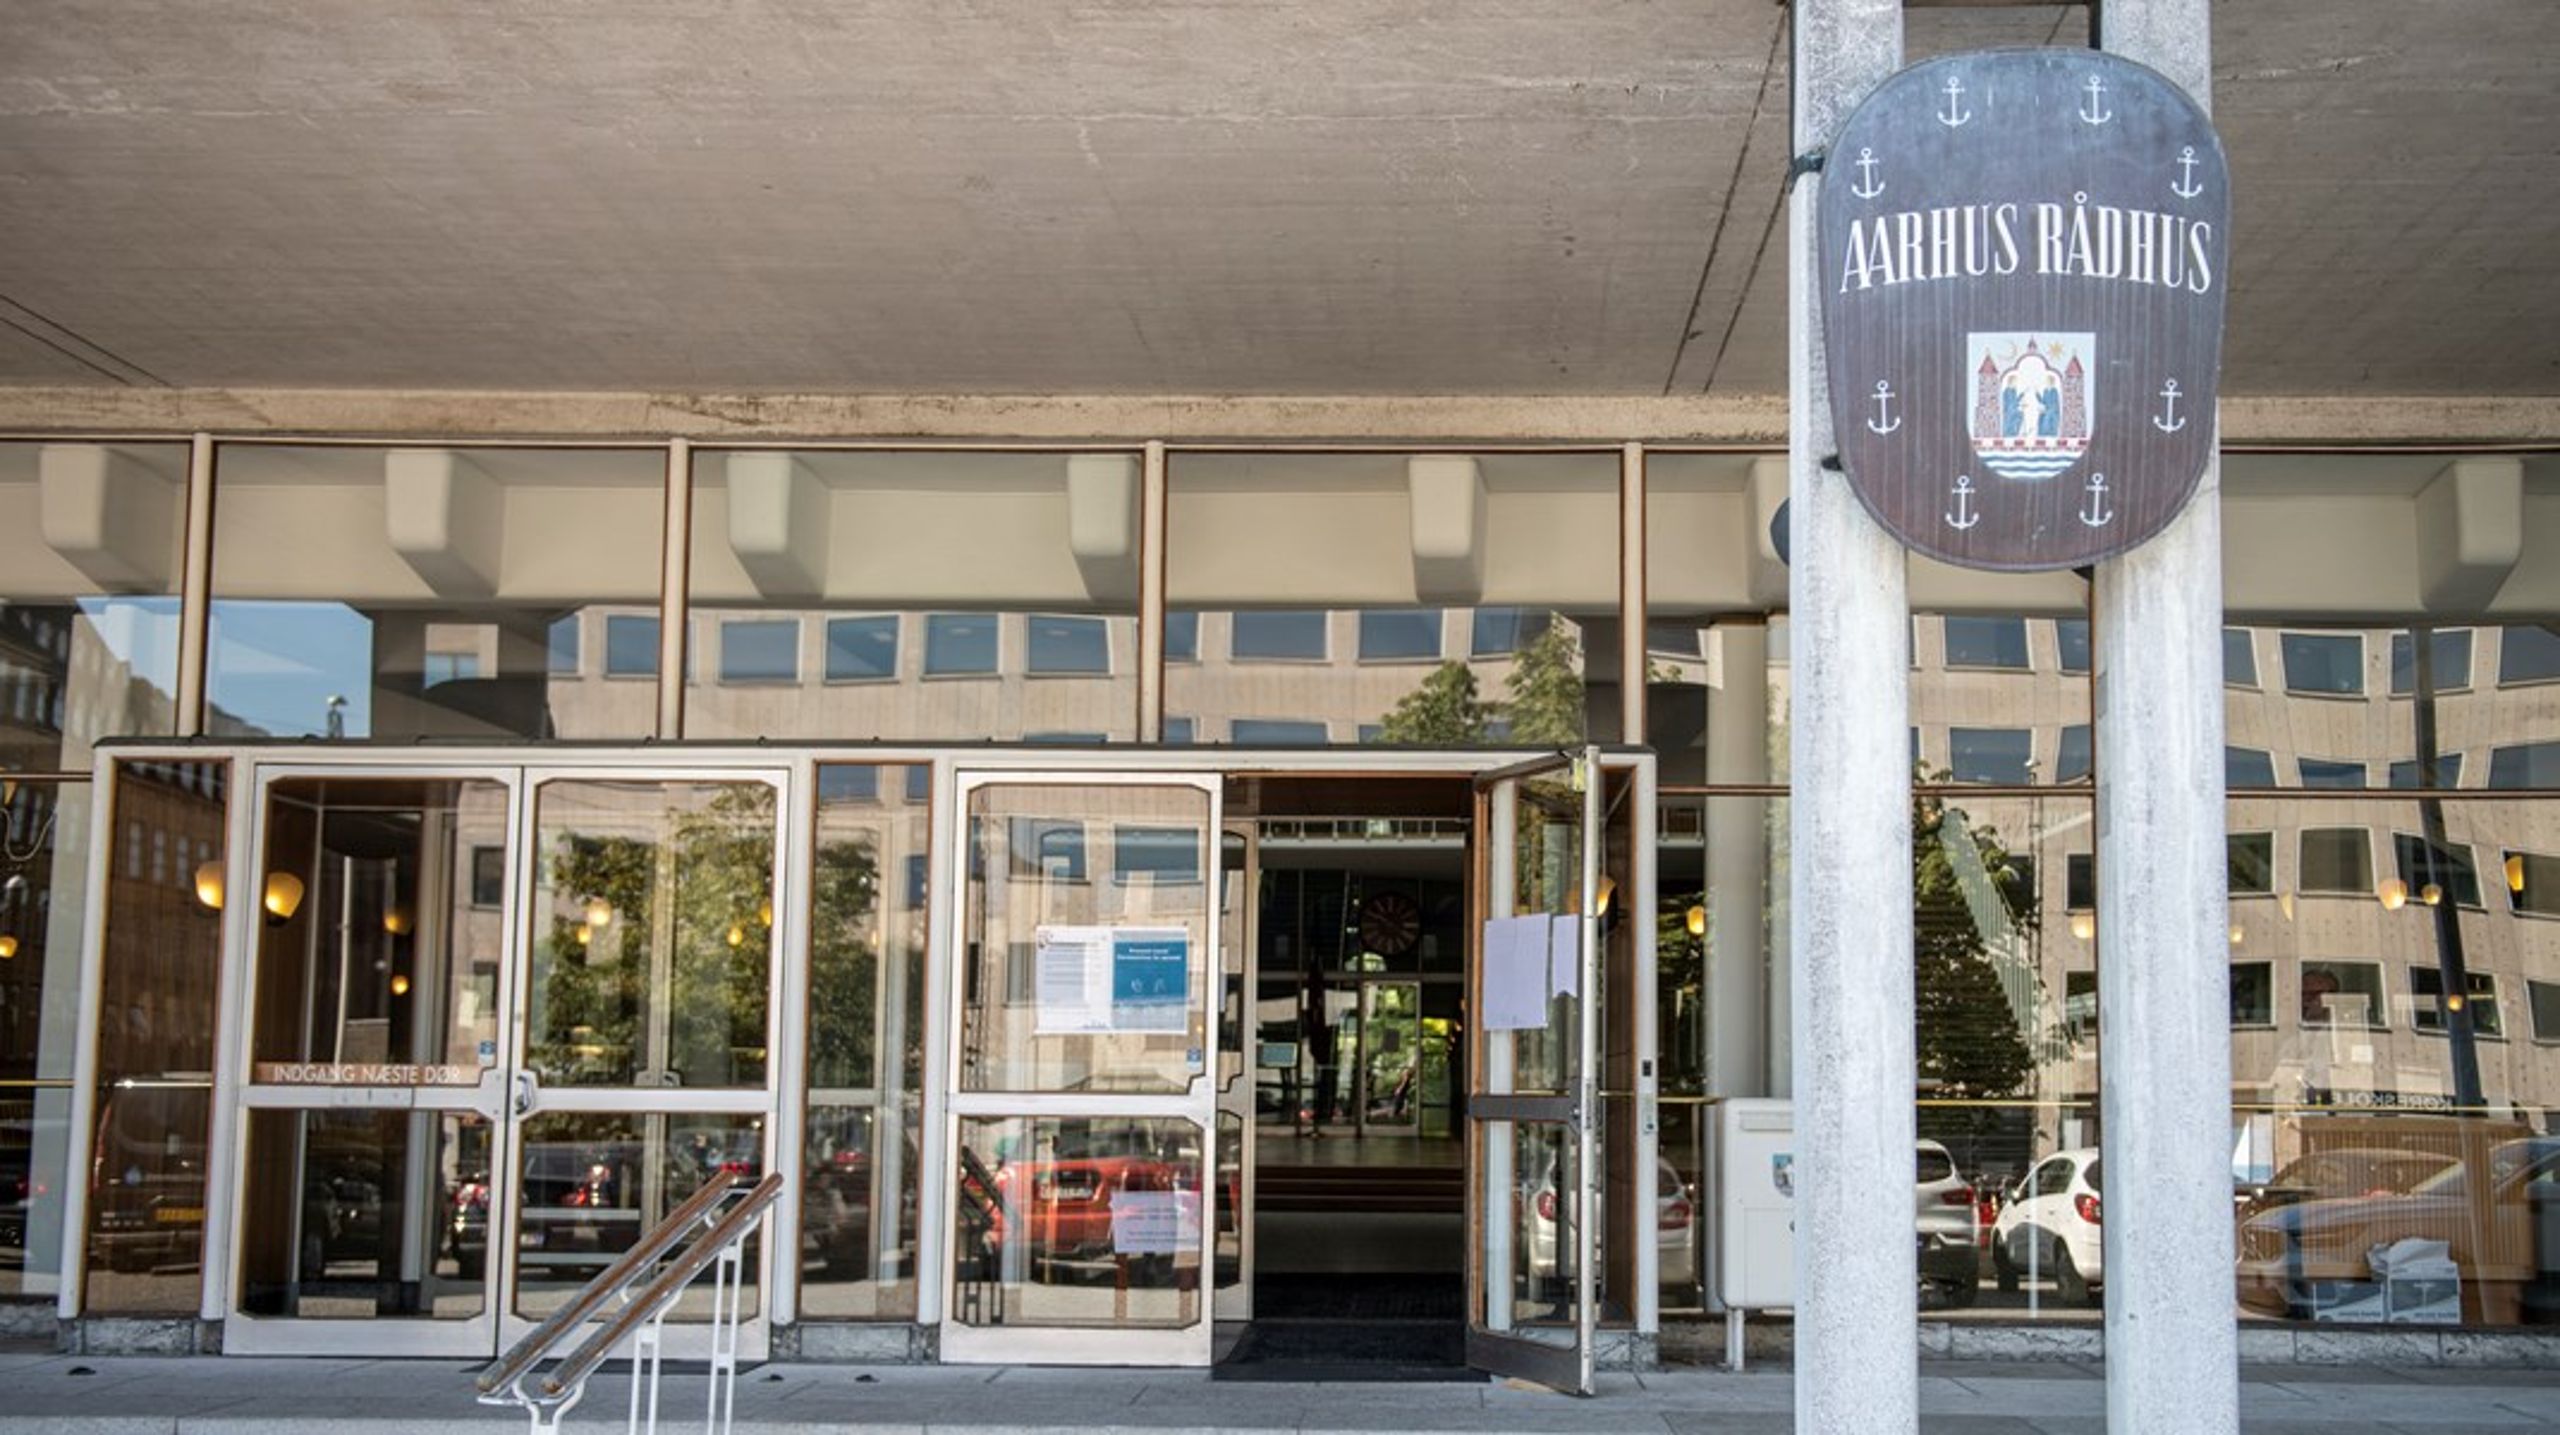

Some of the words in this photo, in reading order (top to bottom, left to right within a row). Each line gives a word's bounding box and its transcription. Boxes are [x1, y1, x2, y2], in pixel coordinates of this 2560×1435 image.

[1839, 203, 2020, 295] AARHUS
[2037, 191, 2212, 295] RÅDHUS
[274, 1064, 355, 1083] INDGANG
[363, 1064, 418, 1083] NÆSTE
[424, 1065, 461, 1083] DØR
